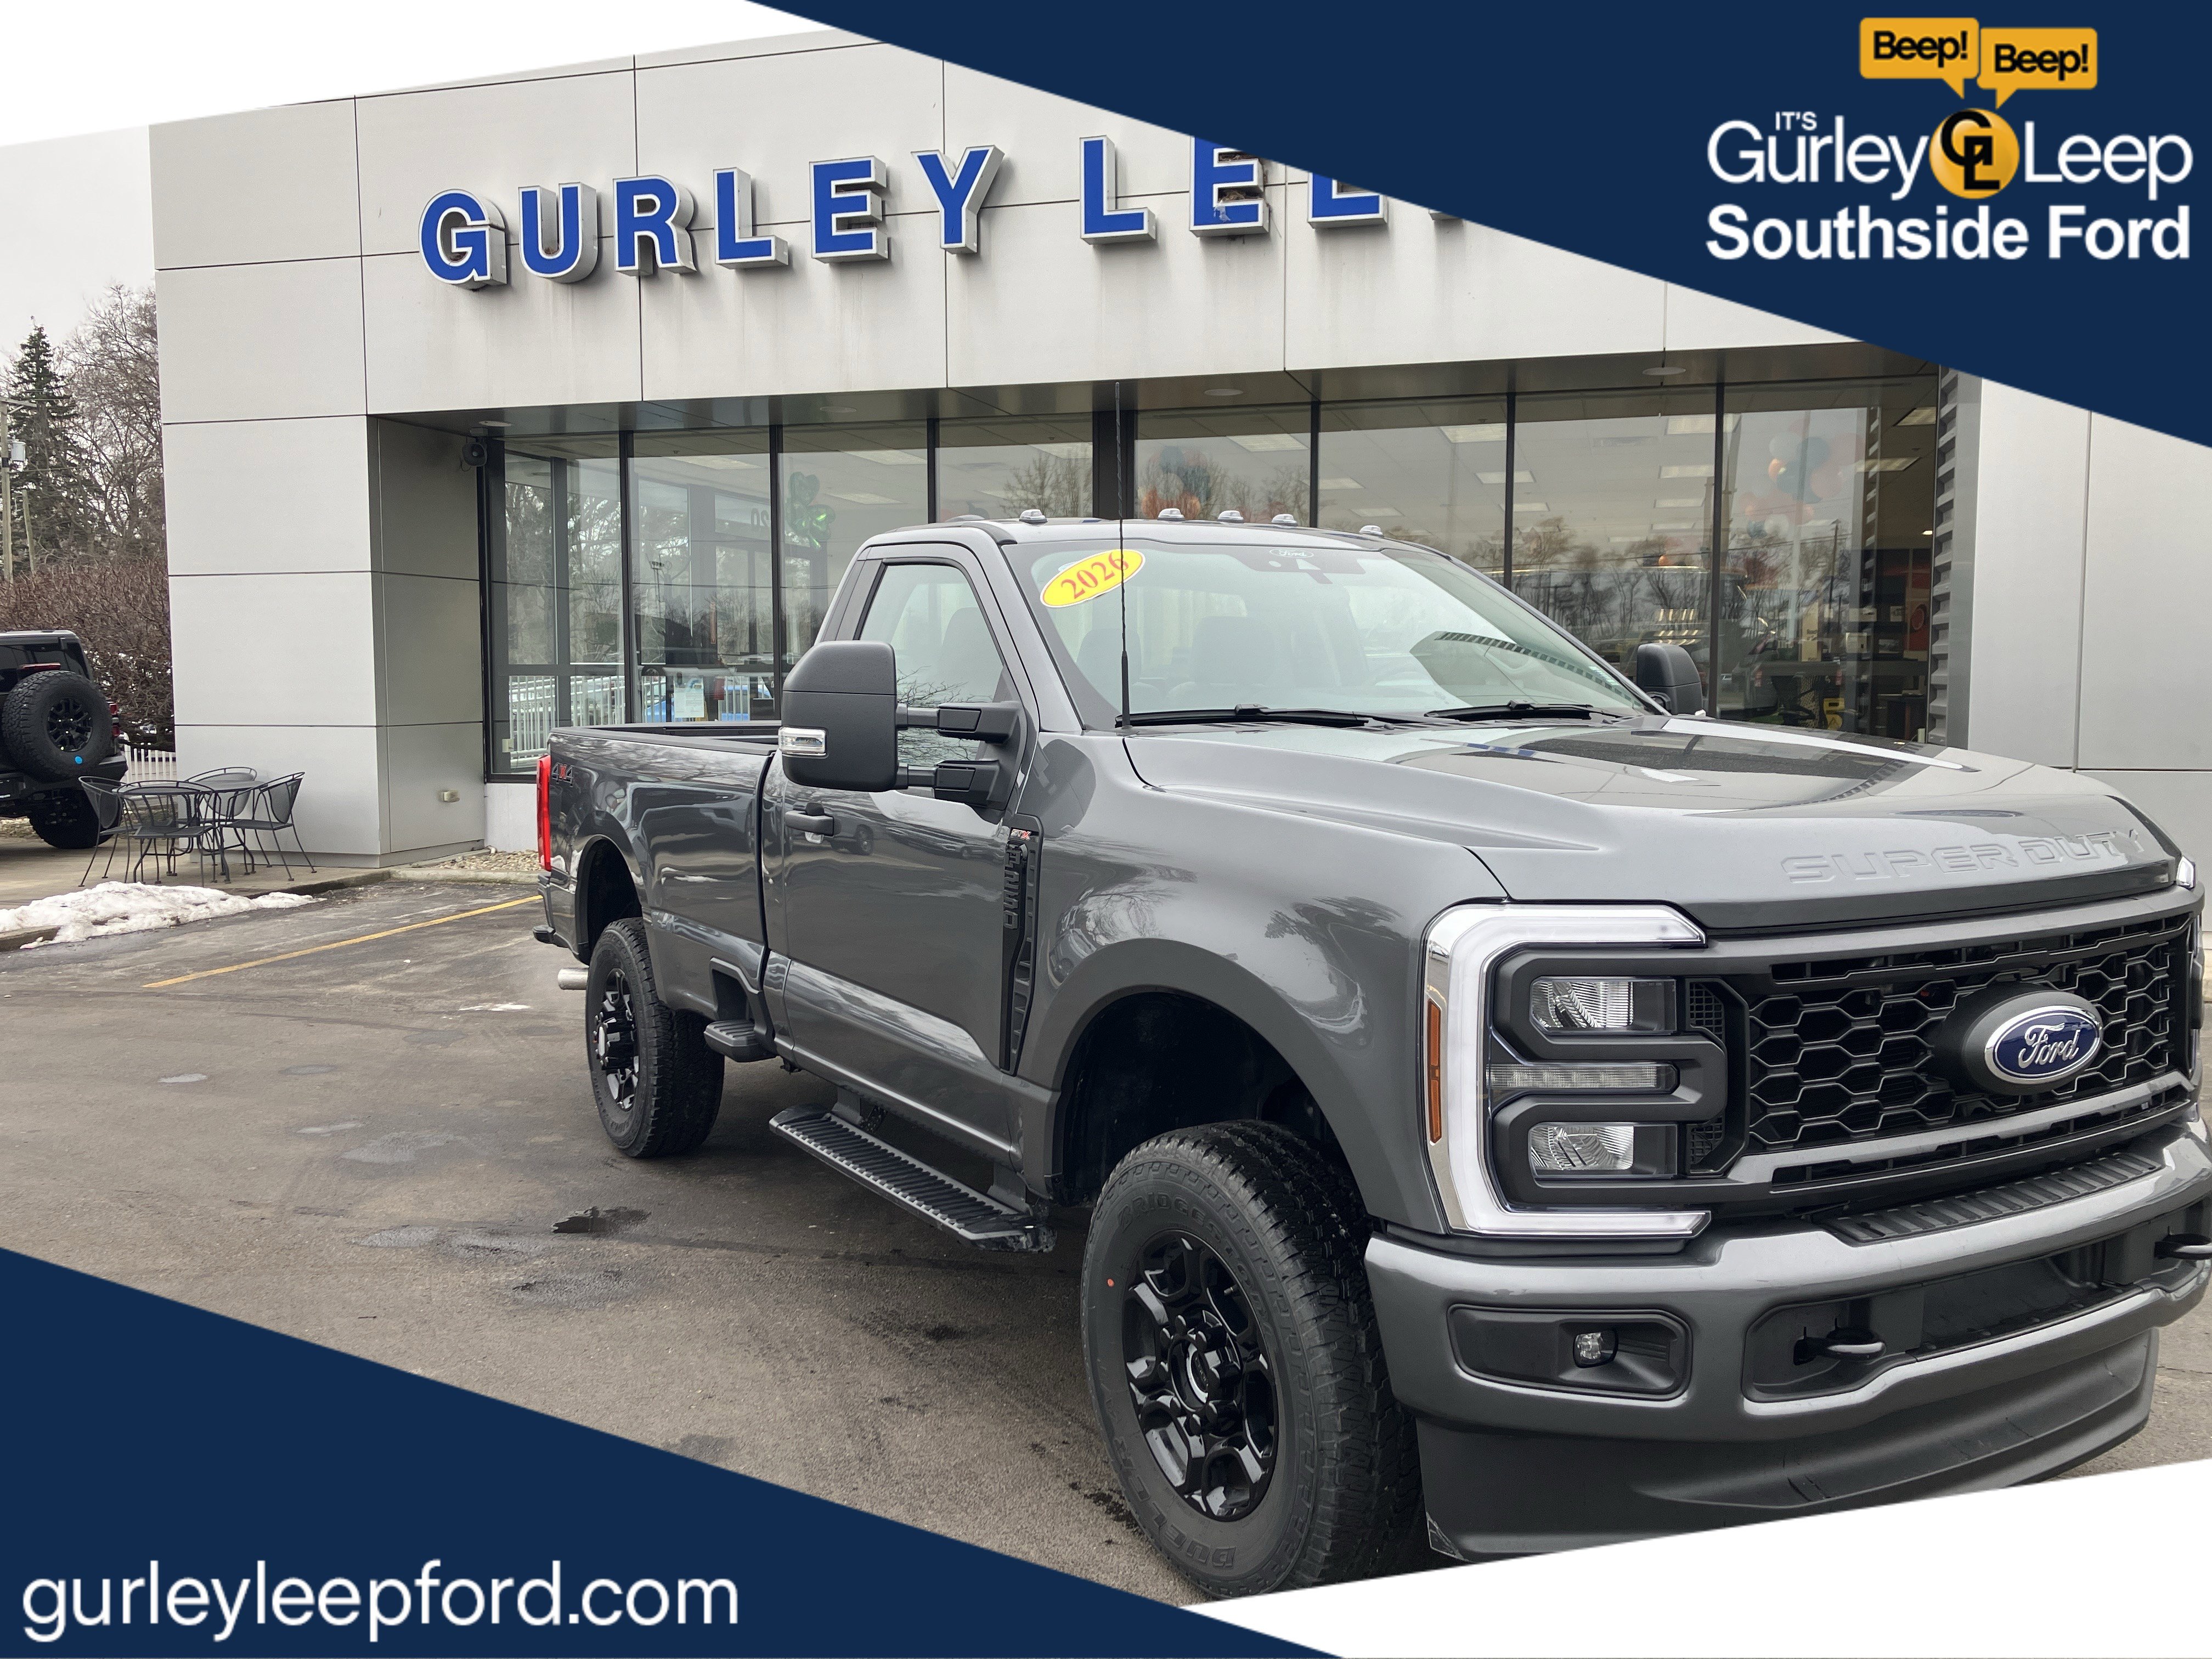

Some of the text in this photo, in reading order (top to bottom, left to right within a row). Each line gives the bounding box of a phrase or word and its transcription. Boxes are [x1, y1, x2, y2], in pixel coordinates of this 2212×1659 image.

[419, 135, 1462, 289] GURLEY LE
[1060, 551, 1129, 600] 2026
[1011, 828, 1032, 841] STX
[1781, 828, 2145, 884] SUPER DUTY
[2018, 1022, 2081, 1069] Ford
